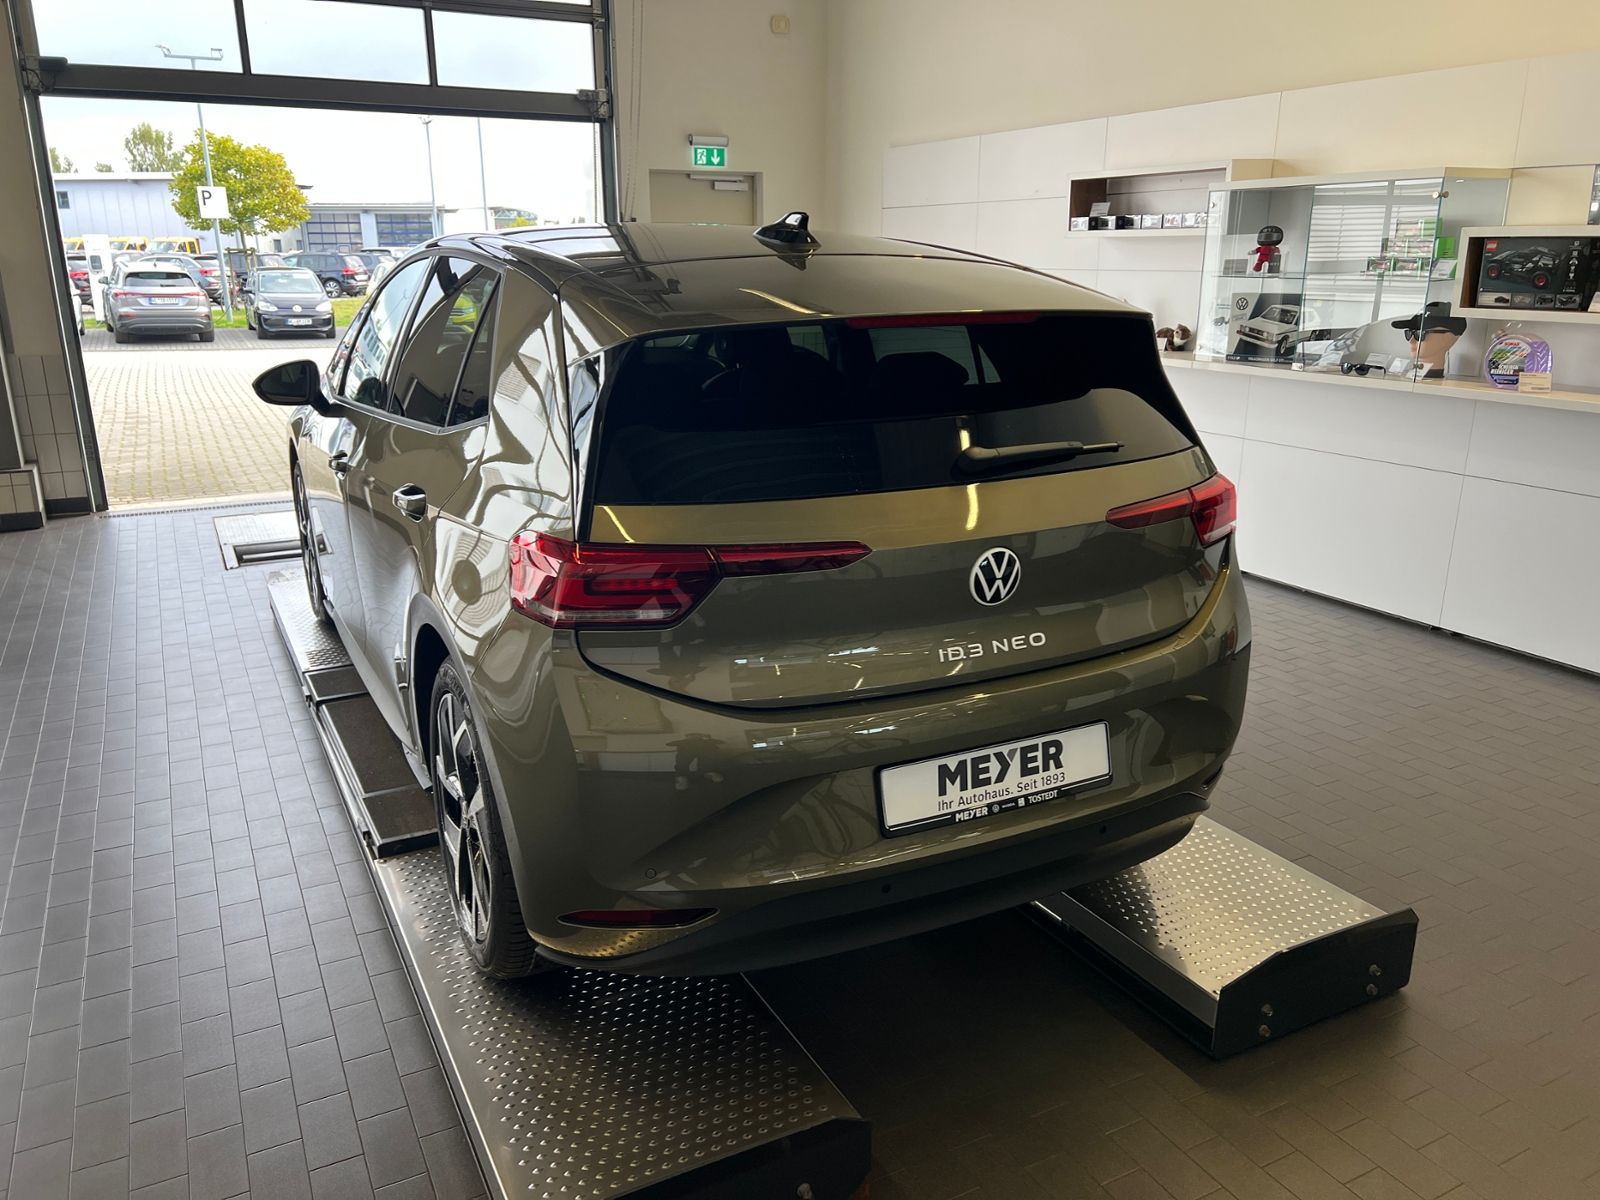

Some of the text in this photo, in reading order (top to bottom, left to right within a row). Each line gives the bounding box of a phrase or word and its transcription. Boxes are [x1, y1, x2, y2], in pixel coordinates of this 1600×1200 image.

[201, 190, 212, 206] P
[991, 632, 1047, 655] NEO
[938, 739, 1064, 797] MEYER
[938, 800, 954, 812] Ihr
[957, 788, 1014, 807] Autohaus.
[1016, 780, 1038, 793] Seit
[1041, 772, 1066, 787] 1893
[955, 806, 989, 822] MEYER
[1027, 789, 1059, 804] TOSTEDT
